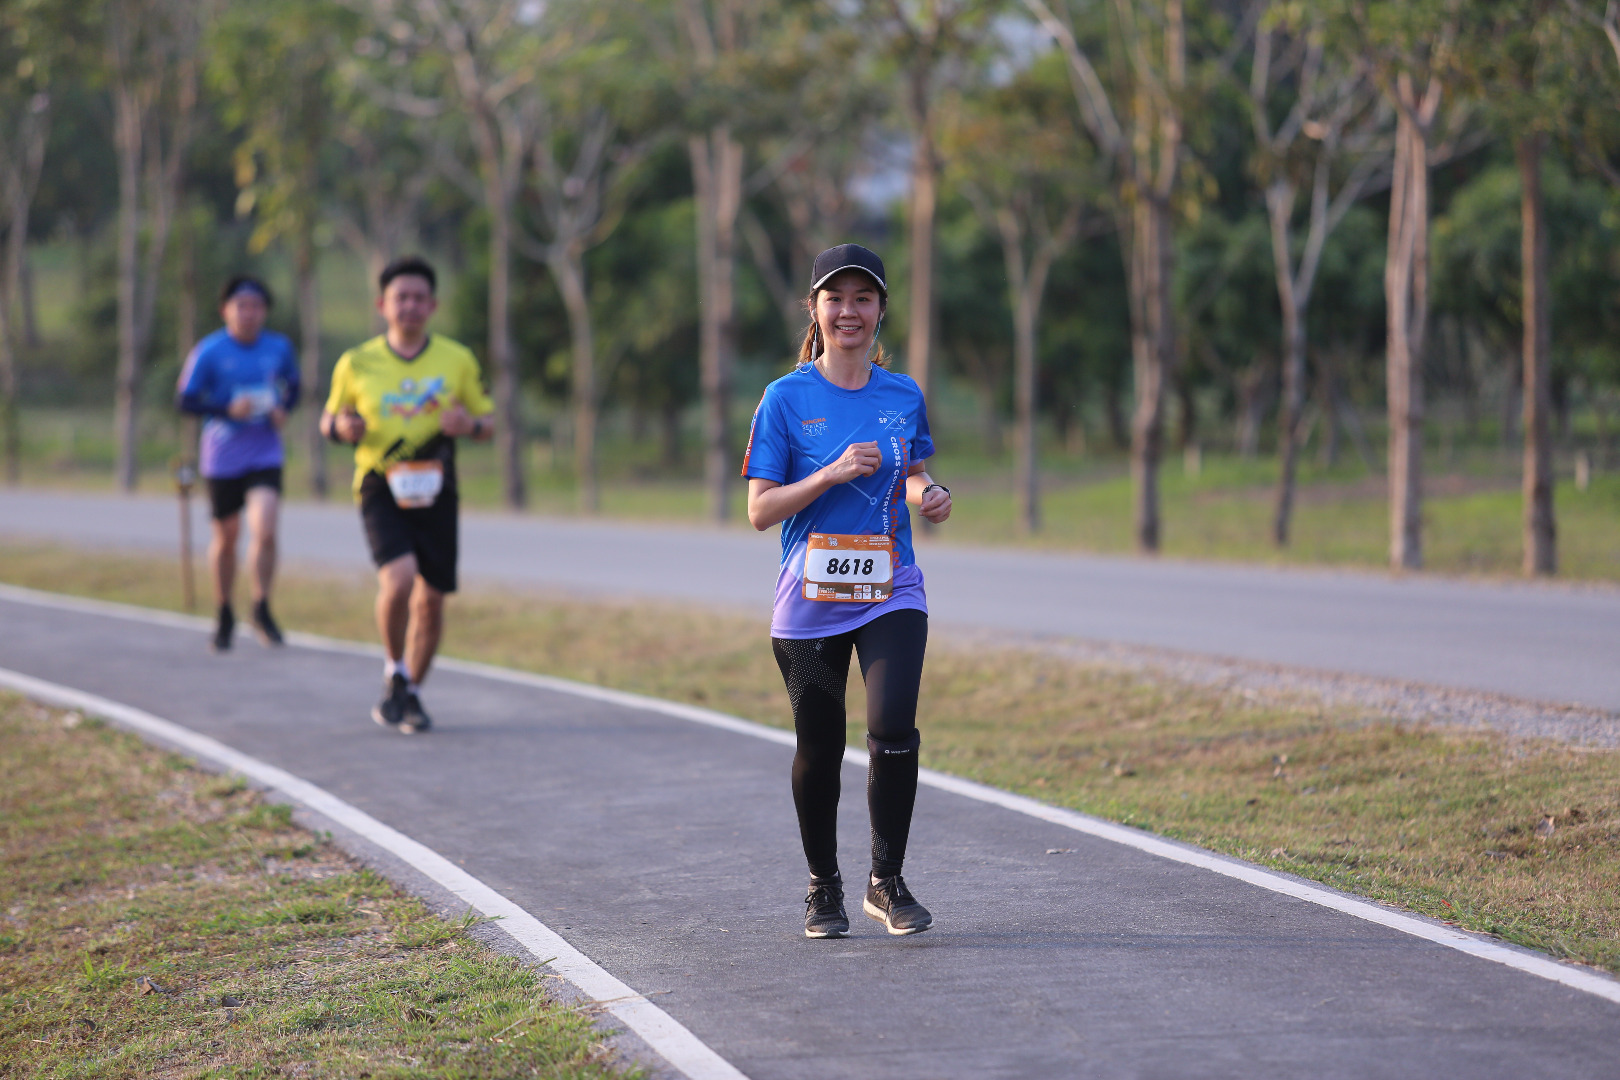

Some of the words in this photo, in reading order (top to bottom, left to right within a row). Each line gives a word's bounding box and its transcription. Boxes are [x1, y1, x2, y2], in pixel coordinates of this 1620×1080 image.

[890, 436, 900, 467] CROSS
[899, 436, 908, 476] SINGHA
[882, 470, 900, 513] COUNTRY
[891, 479, 904, 506] PARK
[890, 508, 898, 549] CHIANG
[826, 558, 874, 575] 8618
